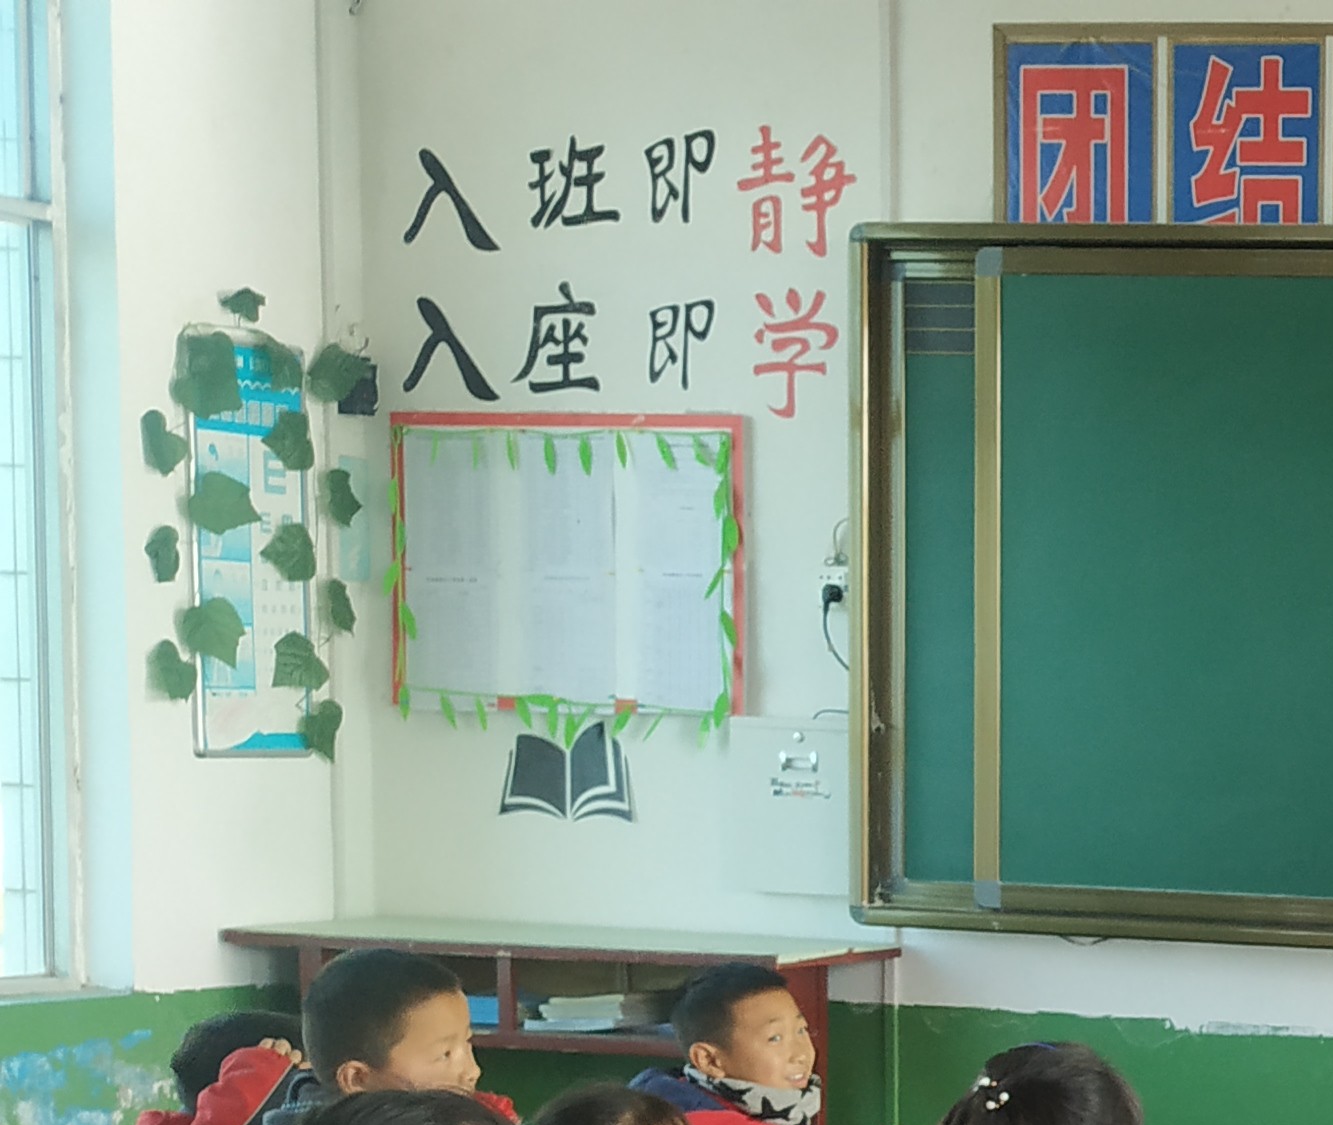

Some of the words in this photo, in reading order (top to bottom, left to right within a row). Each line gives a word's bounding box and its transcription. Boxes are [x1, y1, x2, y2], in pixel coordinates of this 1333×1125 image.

[403, 125, 858, 257] 入班即静
[401, 282, 840, 419] 入座即学
